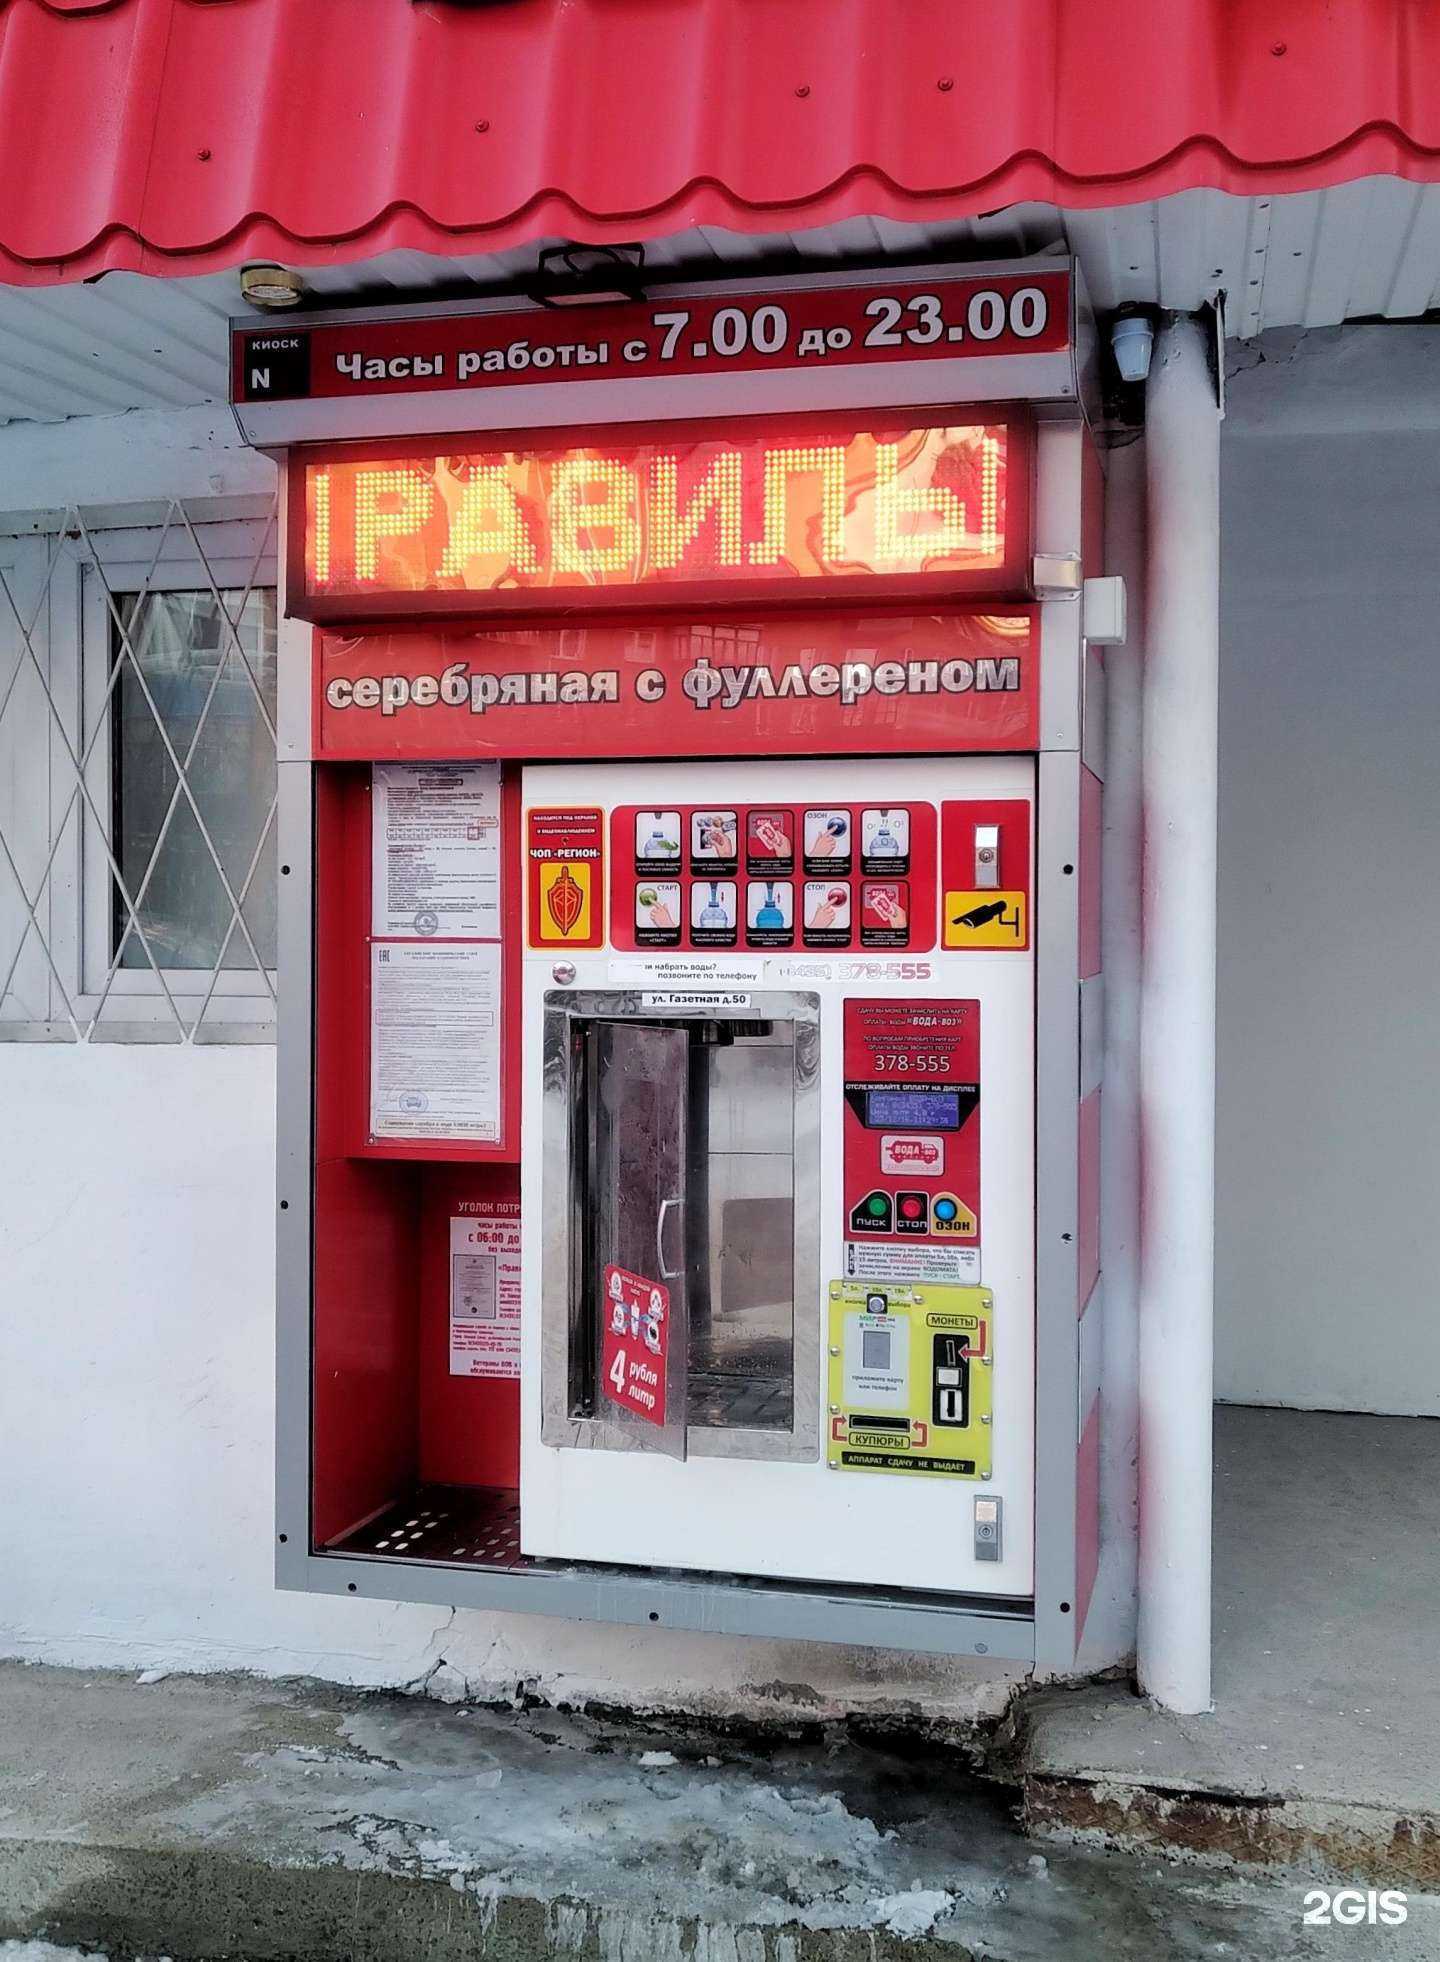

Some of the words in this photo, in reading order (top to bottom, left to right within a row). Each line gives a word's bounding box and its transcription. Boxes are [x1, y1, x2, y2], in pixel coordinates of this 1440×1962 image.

[336, 353, 443, 380] Часы
[458, 340, 608, 381] работы
[623, 339, 648, 362] с
[653, 305, 788, 359] 7.00
[798, 328, 852, 356] до
[864, 288, 1047, 347] 23.00
[251, 367, 271, 389] N
[327, 663, 619, 716] серебряная
[634, 670, 666, 702] с
[682, 655, 1021, 712] фуллереном
[807, 812, 828, 820] ОЗОН
[529, 848, 552, 858] ЧОП
[657, 884, 678, 892] СТАРТ
[807, 884, 826, 892] СТОП
[654, 963, 688, 971] набрать
[690, 963, 717, 972] воды?
[838, 962, 931, 980] 378-555
[716, 972, 757, 982] телефону
[651, 995, 666, 1004] ул.
[669, 994, 720, 1003] Газетная
[874, 1055, 951, 1072] 378-555
[845, 1083, 901, 1091] ОТСЛЕЖИВАЙТЕ
[458, 1202, 494, 1212] УГОЛОК
[856, 1217, 887, 1226] ПУСК
[897, 1219, 928, 1228] СТОП
[935, 1221, 970, 1231] ОЗОН
[931, 1315, 973, 1327] МОНЕТЫ
[610, 1349, 626, 1393] 4
[629, 1361, 658, 1387] рубля
[628, 1383, 656, 1411] литр
[855, 1435, 904, 1448] КУПЮРЫ
[848, 1456, 883, 1465] АППАРАТ
[888, 1457, 913, 1467] СДАЧУ
[918, 1460, 929, 1468] НЕ
[933, 1461, 965, 1471] ВЫДАЕТ
